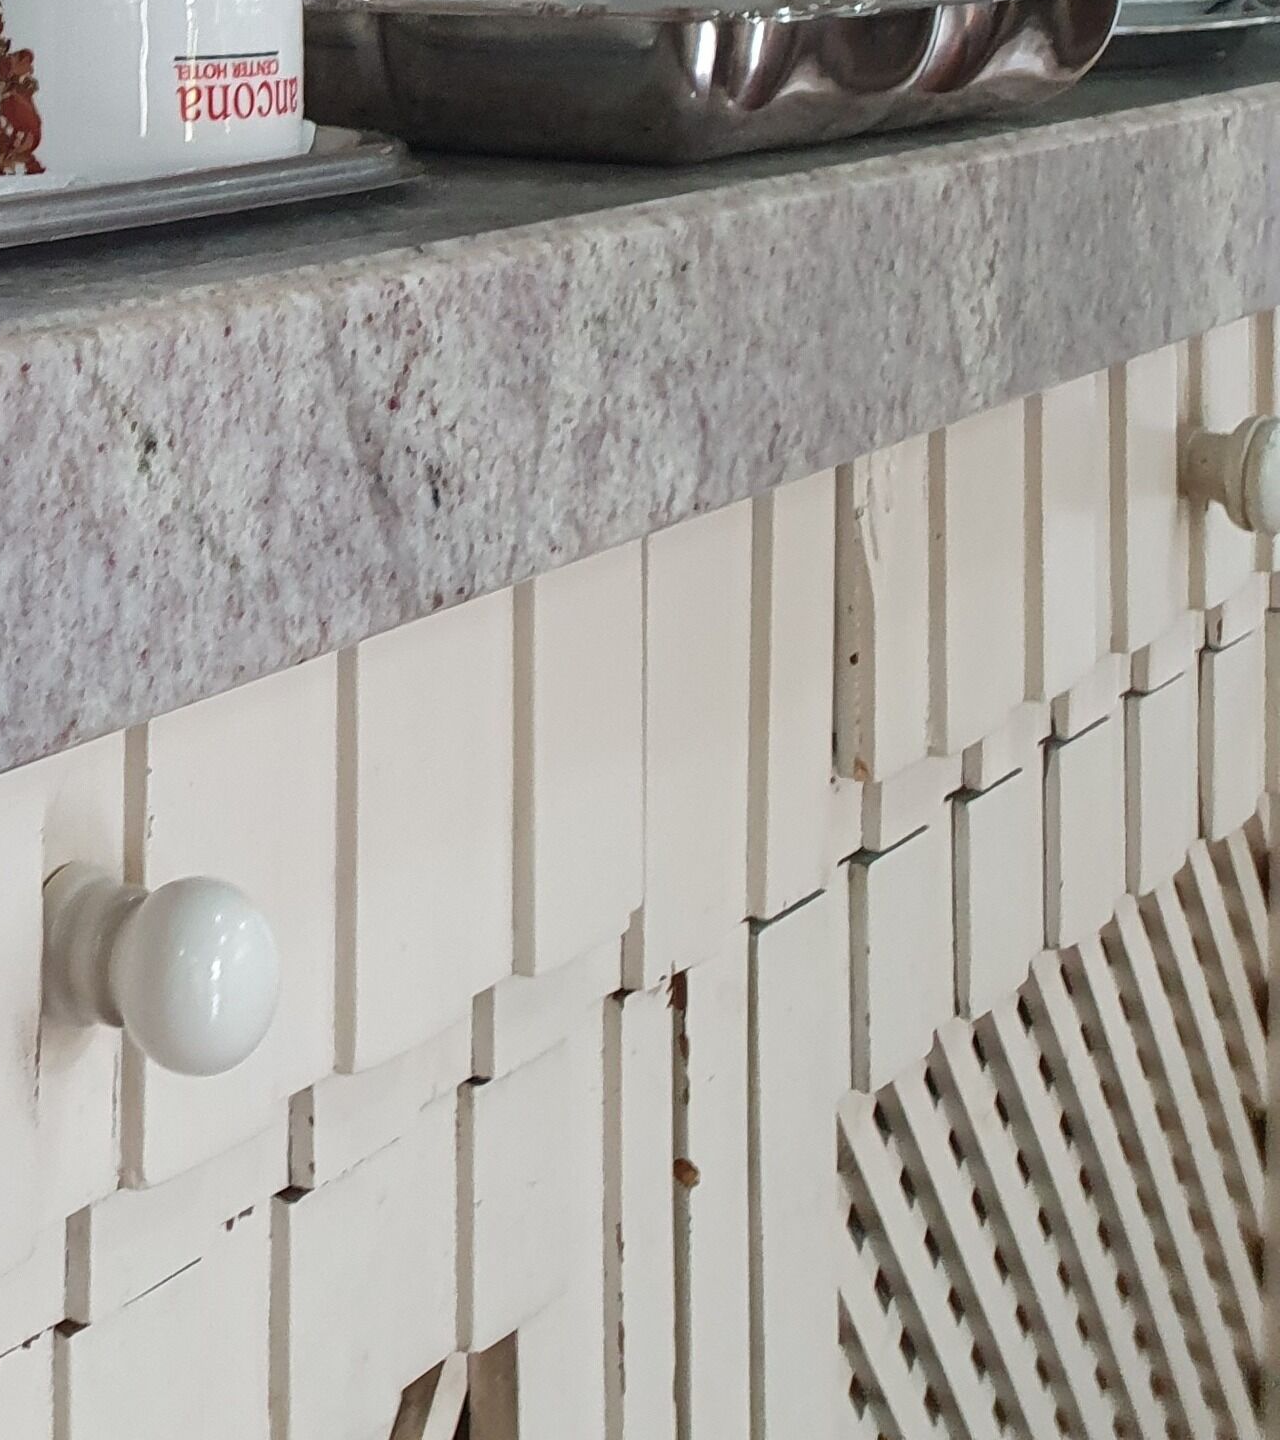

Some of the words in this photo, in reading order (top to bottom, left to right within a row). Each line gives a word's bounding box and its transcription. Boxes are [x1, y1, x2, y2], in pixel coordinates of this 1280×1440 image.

[173, 64, 228, 81] HOTEL
[232, 59, 279, 78] CENTER
[176, 76, 298, 123] ancona
